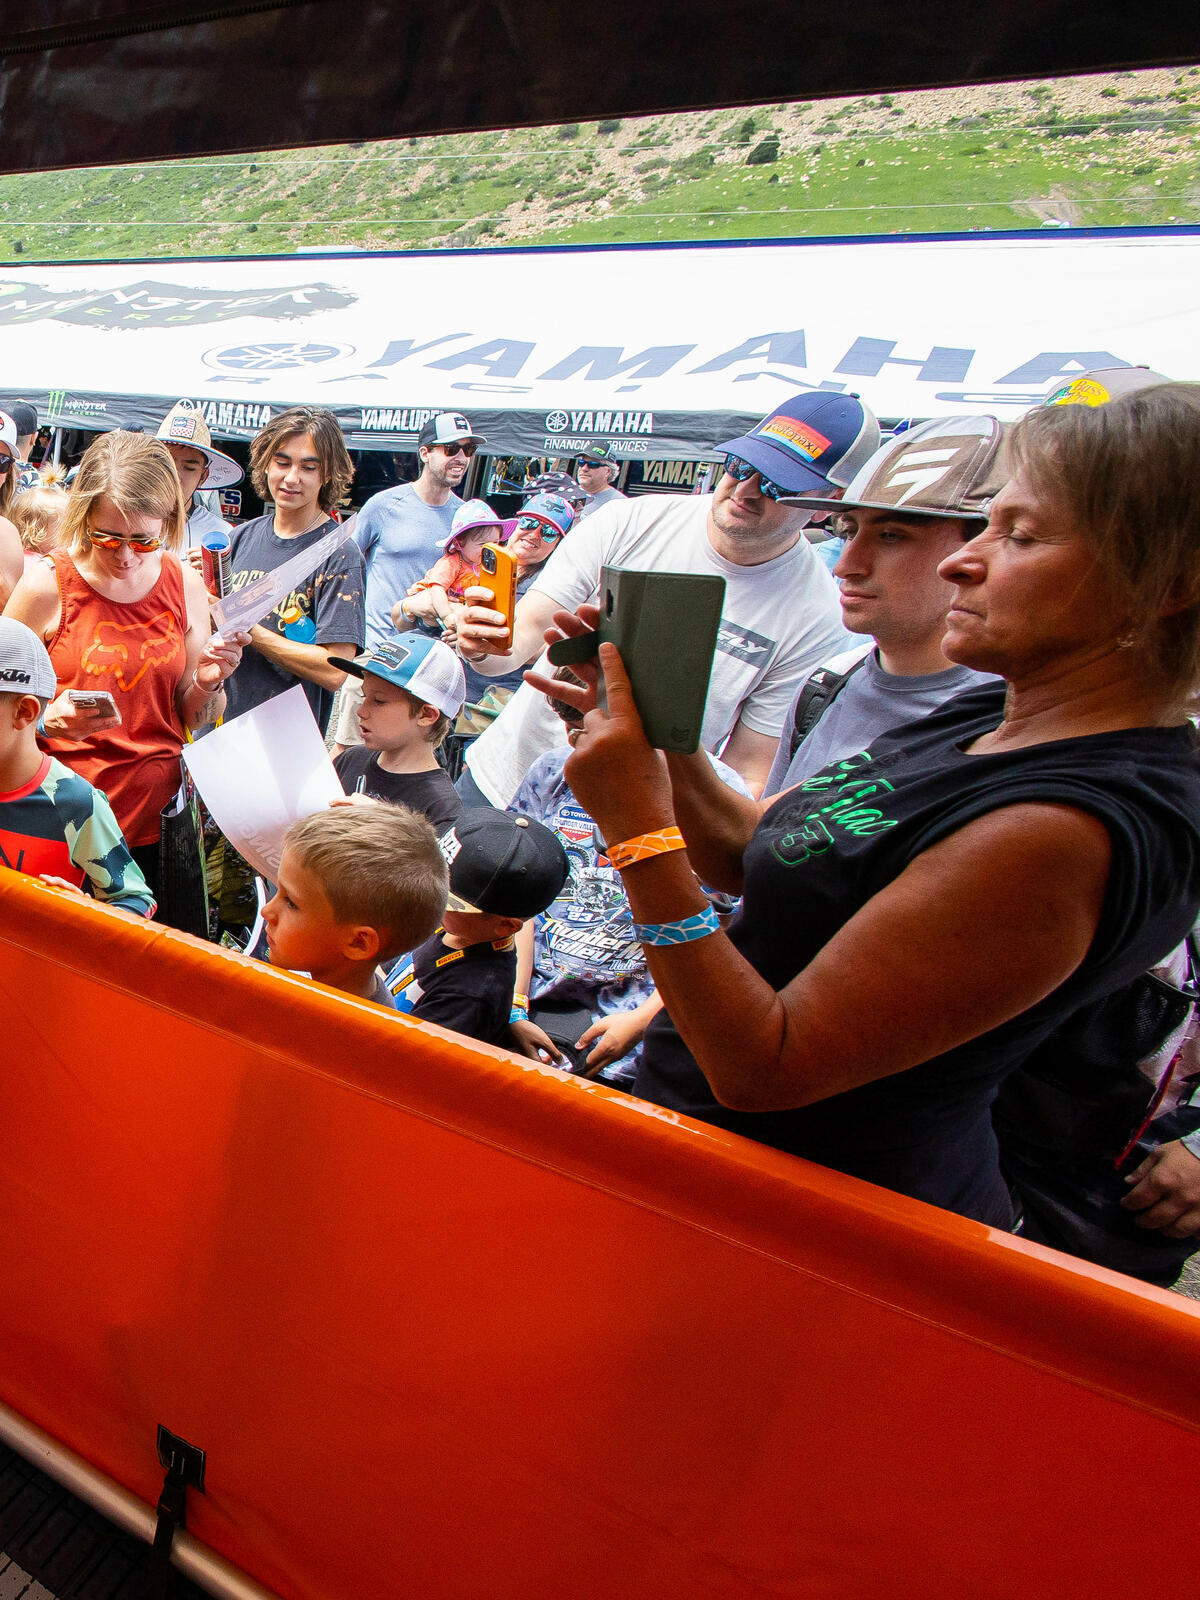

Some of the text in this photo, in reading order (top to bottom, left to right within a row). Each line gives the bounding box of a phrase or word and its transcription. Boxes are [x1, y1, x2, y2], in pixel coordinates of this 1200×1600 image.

[364, 329, 1135, 384] YAMAHA
[196, 400, 272, 429] YAMAHA
[570, 411, 654, 434] YAMAHA
